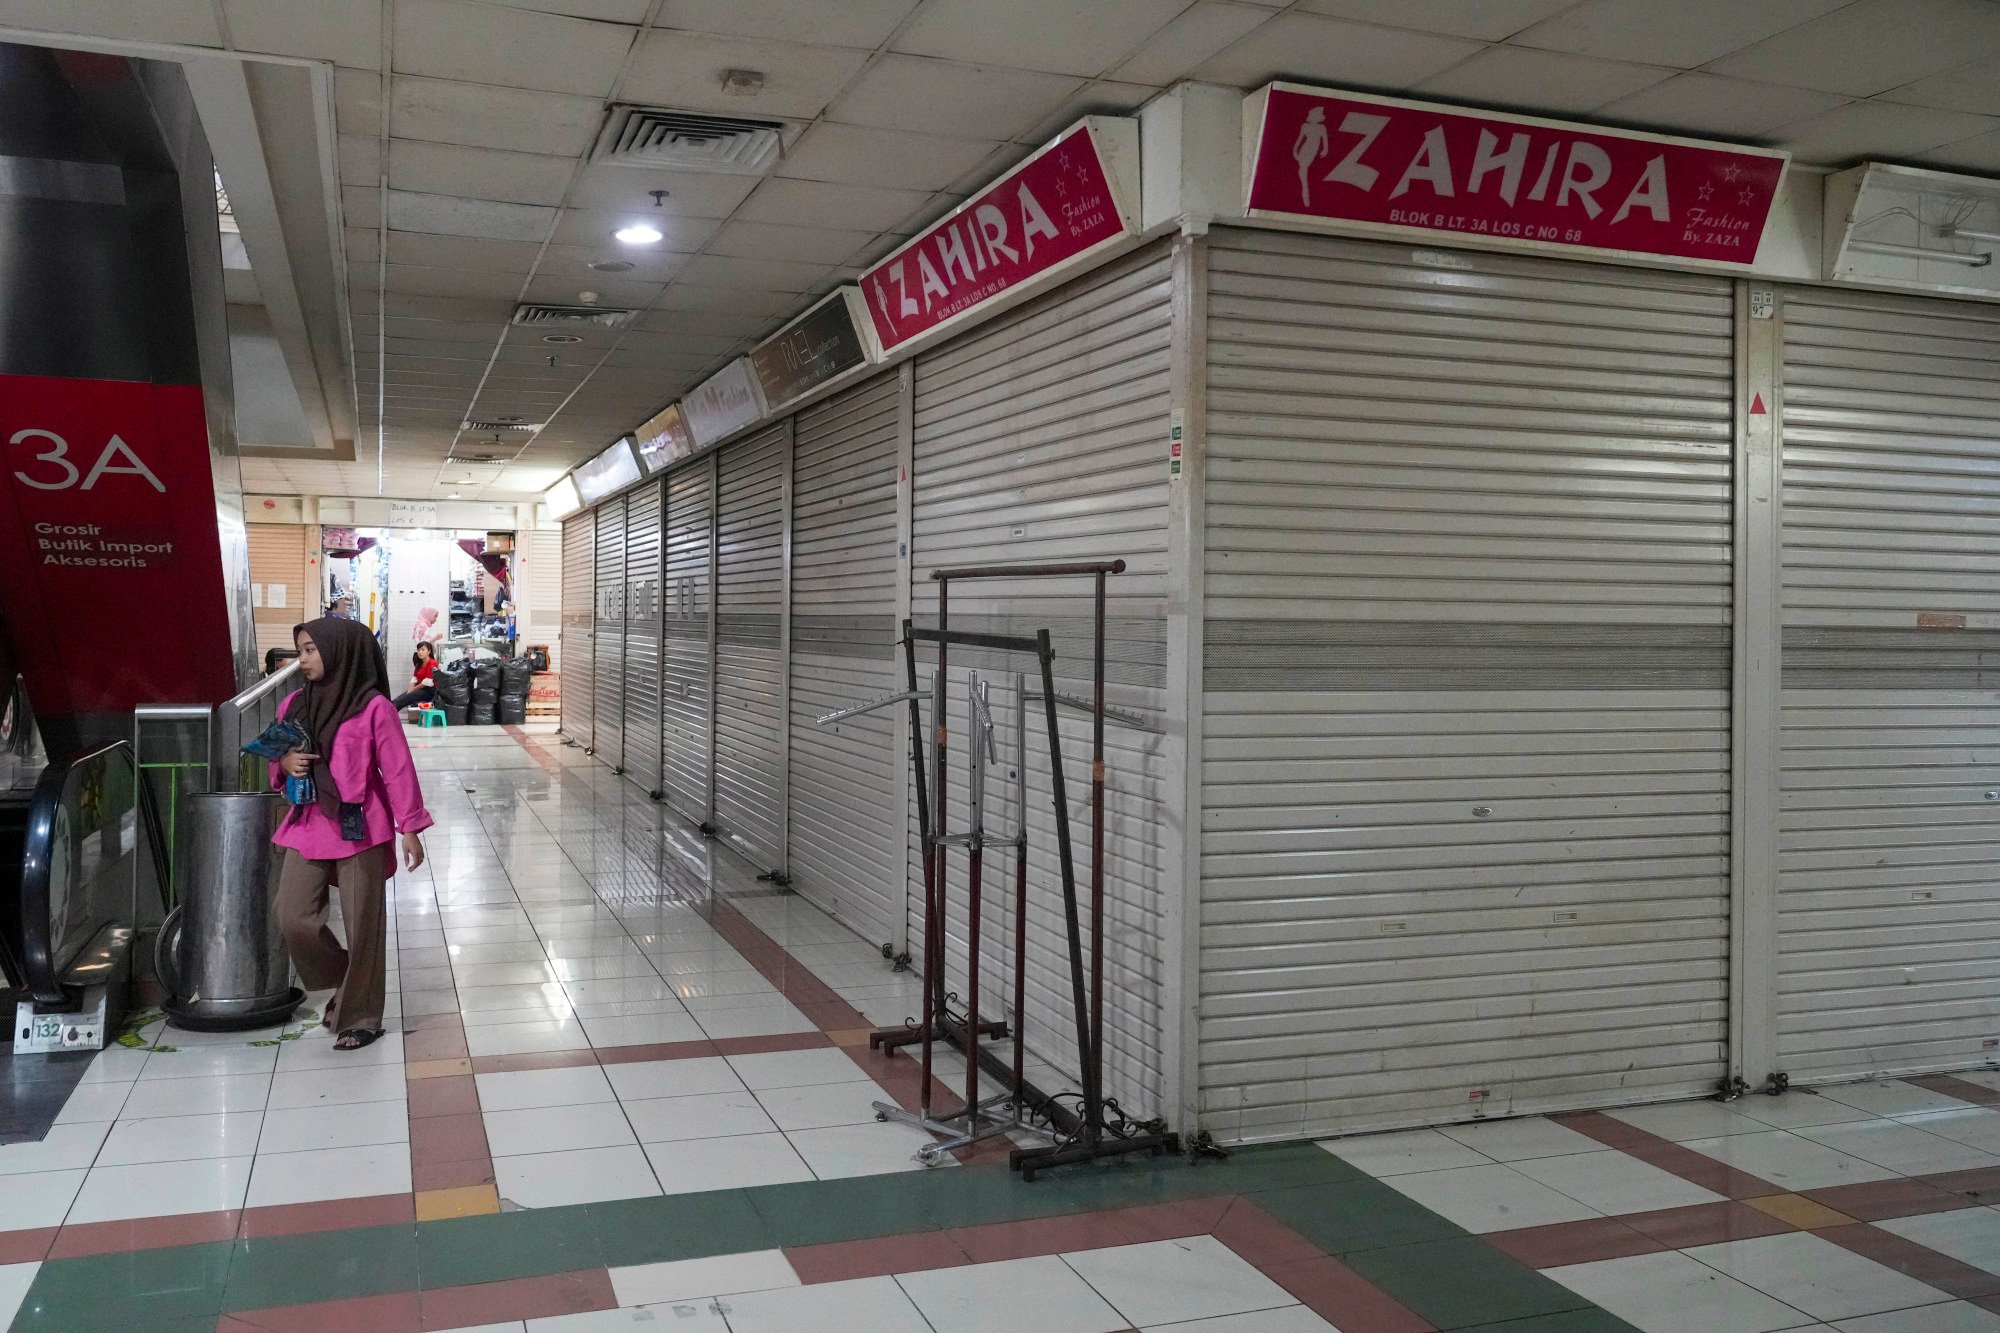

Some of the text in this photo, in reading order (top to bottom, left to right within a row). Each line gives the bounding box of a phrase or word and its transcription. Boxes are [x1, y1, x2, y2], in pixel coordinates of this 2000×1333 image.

[1322, 111, 1671, 226] ZAHIRA
[1062, 195, 1101, 225] Fashion
[1686, 207, 1751, 231] Fashion
[1081, 212, 1105, 230] ZAZA
[1389, 209, 1430, 225] BLOK
[1433, 214, 1445, 227] B
[1470, 218, 1488, 232] 3A
[1492, 221, 1521, 235] LOS
[1524, 225, 1535, 237] C
[1537, 226, 1558, 239] NO
[1564, 229, 1582, 242] 68
[1705, 232, 1740, 246] ZAZA
[889, 180, 1060, 320] ZAHIRA
[937, 305, 951, 320] BLOK
[970, 290, 983, 302] LOS
[1752, 305, 1764, 316] 97
[9, 428, 167, 493] 3A
[34, 522, 102, 536] Grosir
[38, 538, 173, 554] Butik Import
[43, 554, 147, 568] Aksesoris
[35, 1023, 61, 1038] 132
